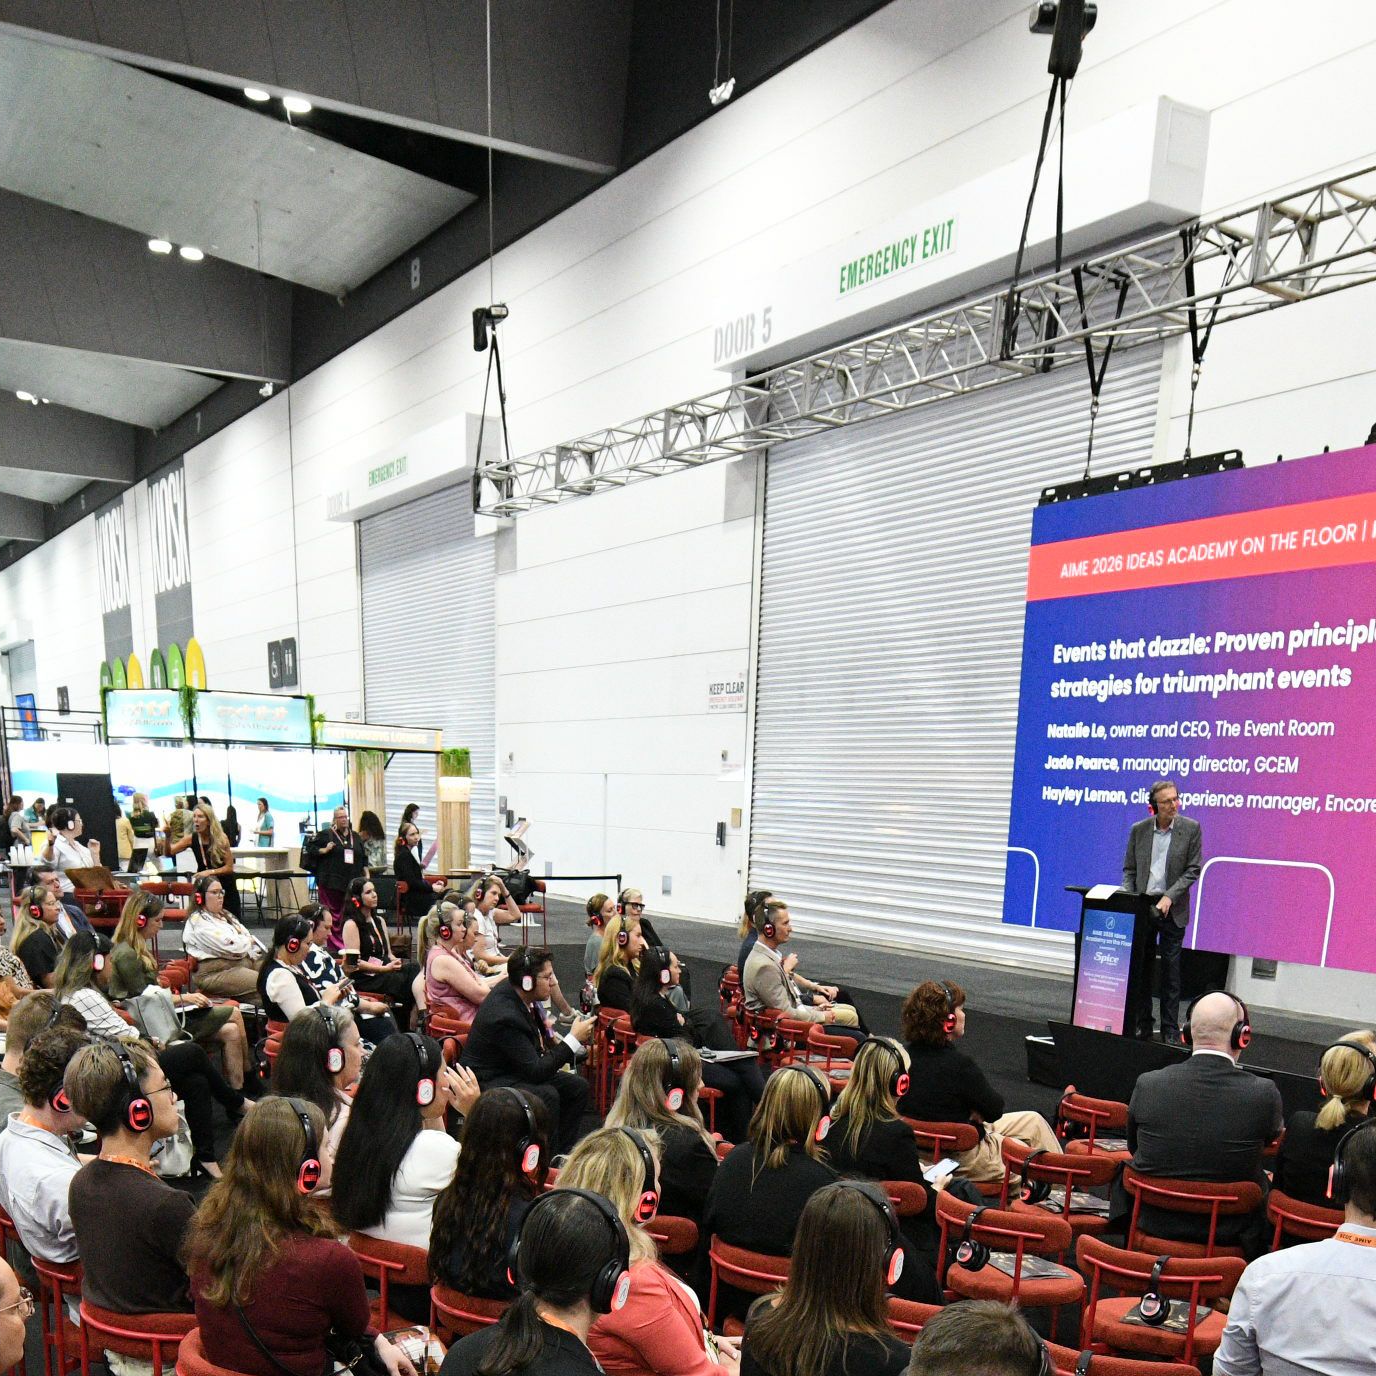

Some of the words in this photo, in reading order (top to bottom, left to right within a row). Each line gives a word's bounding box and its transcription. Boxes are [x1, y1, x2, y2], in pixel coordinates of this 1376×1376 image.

[839, 234, 917, 294] EMERGENCY
[922, 219, 954, 259] EXIT
[714, 312, 755, 364] DOOR
[762, 305, 772, 344] 5
[368, 462, 395, 487] EMERGENCY
[396, 456, 407, 476] EXIT
[148, 467, 191, 595] KIOSK
[96, 503, 131, 614] KIOSK
[1060, 563, 1089, 579] AIME
[1092, 555, 1123, 576] 2026
[1126, 549, 1163, 570] IDEAS
[1167, 539, 1238, 565] ACADEMY
[1241, 536, 1265, 556] ON
[1269, 531, 1297, 551] THE
[1302, 523, 1356, 548] FLOOR
[1053, 641, 1106, 664] Events
[1109, 638, 1145, 660] that
[1148, 633, 1211, 658] dazzle:
[1214, 631, 1284, 653] Proven
[709, 683, 724, 695] KEEP
[726, 681, 744, 694] CLEAR
[1050, 674, 1133, 702] strategies
[1135, 672, 1160, 695] for
[1163, 668, 1274, 699] triumphant
[1277, 664, 1352, 689] events
[1047, 721, 1090, 738] Natalie
[1091, 723, 1107, 740] Le,
[1109, 725, 1149, 738] owner
[1151, 721, 1178, 738] and
[1180, 720, 1211, 740] CEO,
[1215, 720, 1240, 737] The
[1244, 720, 1284, 737] Event
[1287, 720, 1335, 736] Room
[1044, 755, 1074, 770] Jade
[1075, 757, 1120, 772] Pearce,
[1122, 757, 1190, 776] managing
[1193, 755, 1251, 775] director,
[1254, 756, 1299, 773] GCEM
[1042, 786, 1084, 805] Hayley
[1084, 787, 1128, 805] Lemon,
[1130, 789, 1150, 805] clie
[1177, 790, 1243, 811] xperience
[1246, 795, 1321, 815] manager,
[1093, 951, 1119, 965] Spice
